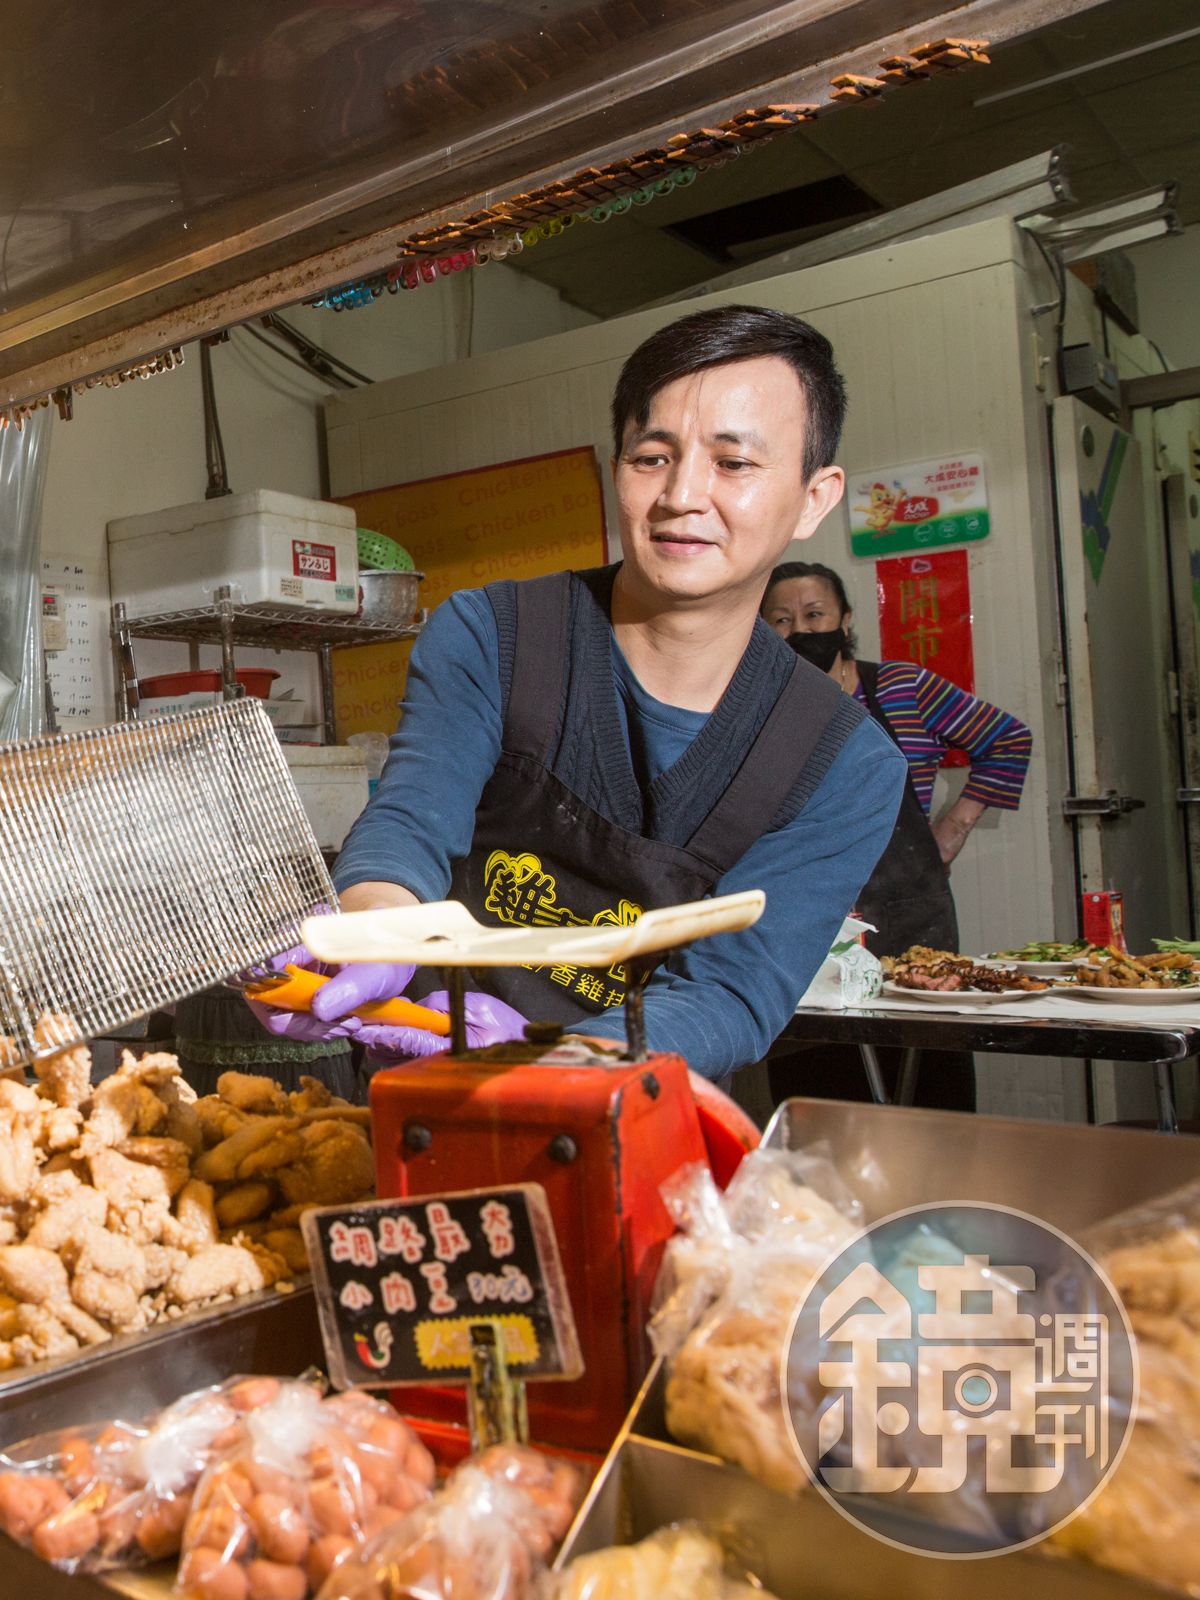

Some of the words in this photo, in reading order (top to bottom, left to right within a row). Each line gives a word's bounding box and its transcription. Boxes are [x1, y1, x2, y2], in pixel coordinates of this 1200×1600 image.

[457, 470, 550, 507] Chicken
[463, 501, 556, 543] Chicken
[563, 486, 600, 513] Bos
[301, 556, 329, 571] サンふじ
[469, 540, 562, 578] Chicken
[570, 530, 597, 550] Bo
[899, 576, 944, 667] 開市
[338, 696, 398, 721] Chick
[467, 1264, 534, 1304] 30元
